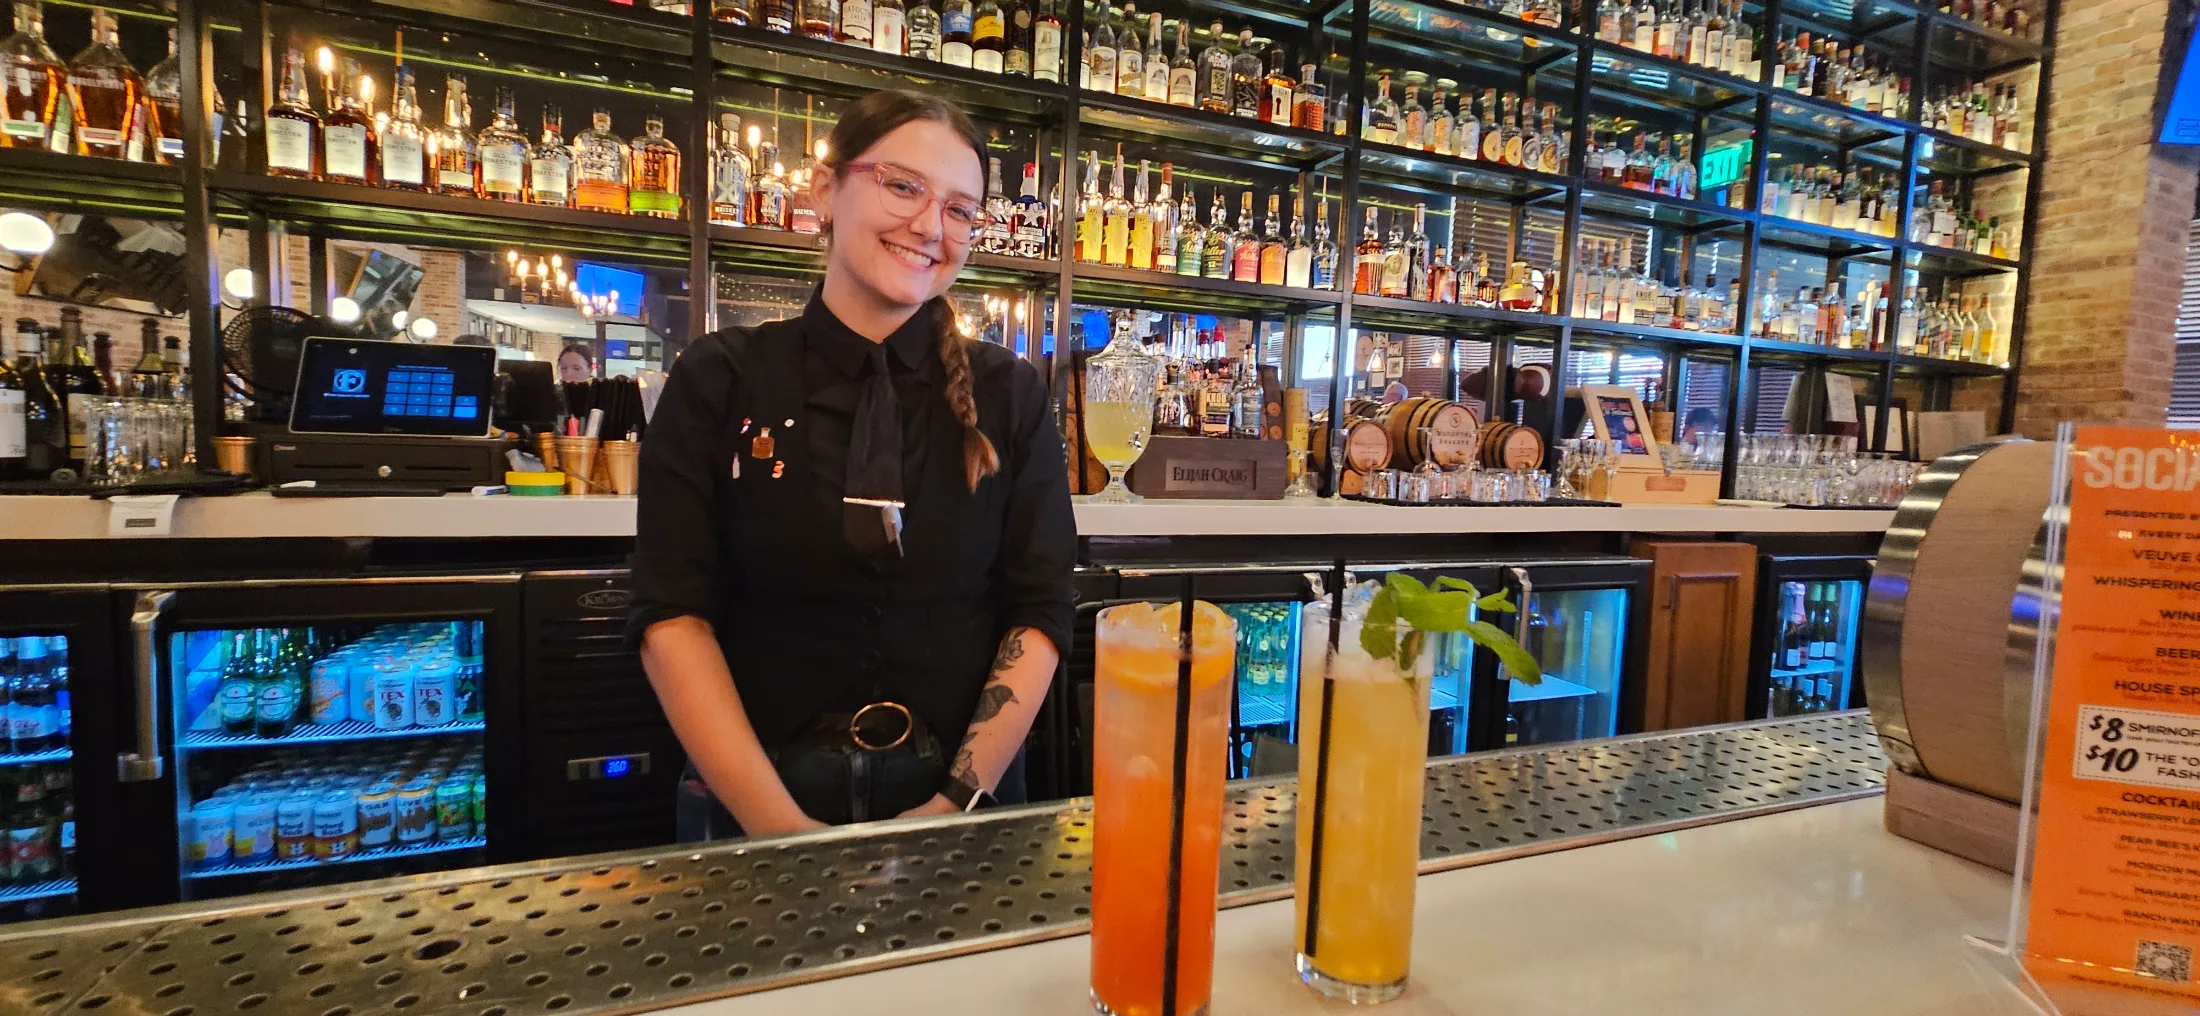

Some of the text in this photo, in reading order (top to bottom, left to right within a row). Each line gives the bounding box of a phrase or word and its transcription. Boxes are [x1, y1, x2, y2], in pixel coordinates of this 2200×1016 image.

[1702, 147, 1743, 187] EXIT
[1207, 260, 1217, 269] 12
[1172, 466, 1249, 485] ELIJAH CRAIG
[2139, 529, 2181, 539] EVERY
[2132, 548, 2193, 562] VEUVE
[418, 687, 443, 697] TEX
[2114, 679, 2176, 695] HOUSE
[379, 690, 406, 701] TEX
[2088, 713, 2126, 742] $8
[2085, 743, 2141, 773] $10
[2145, 751, 2178, 765] THE
[2096, 806, 2181, 822] STRAWBERRY
[2120, 834, 2153, 845] PEAR
[2127, 859, 2184, 874] MOSCOW
[2122, 908, 2167, 921] RANCH
